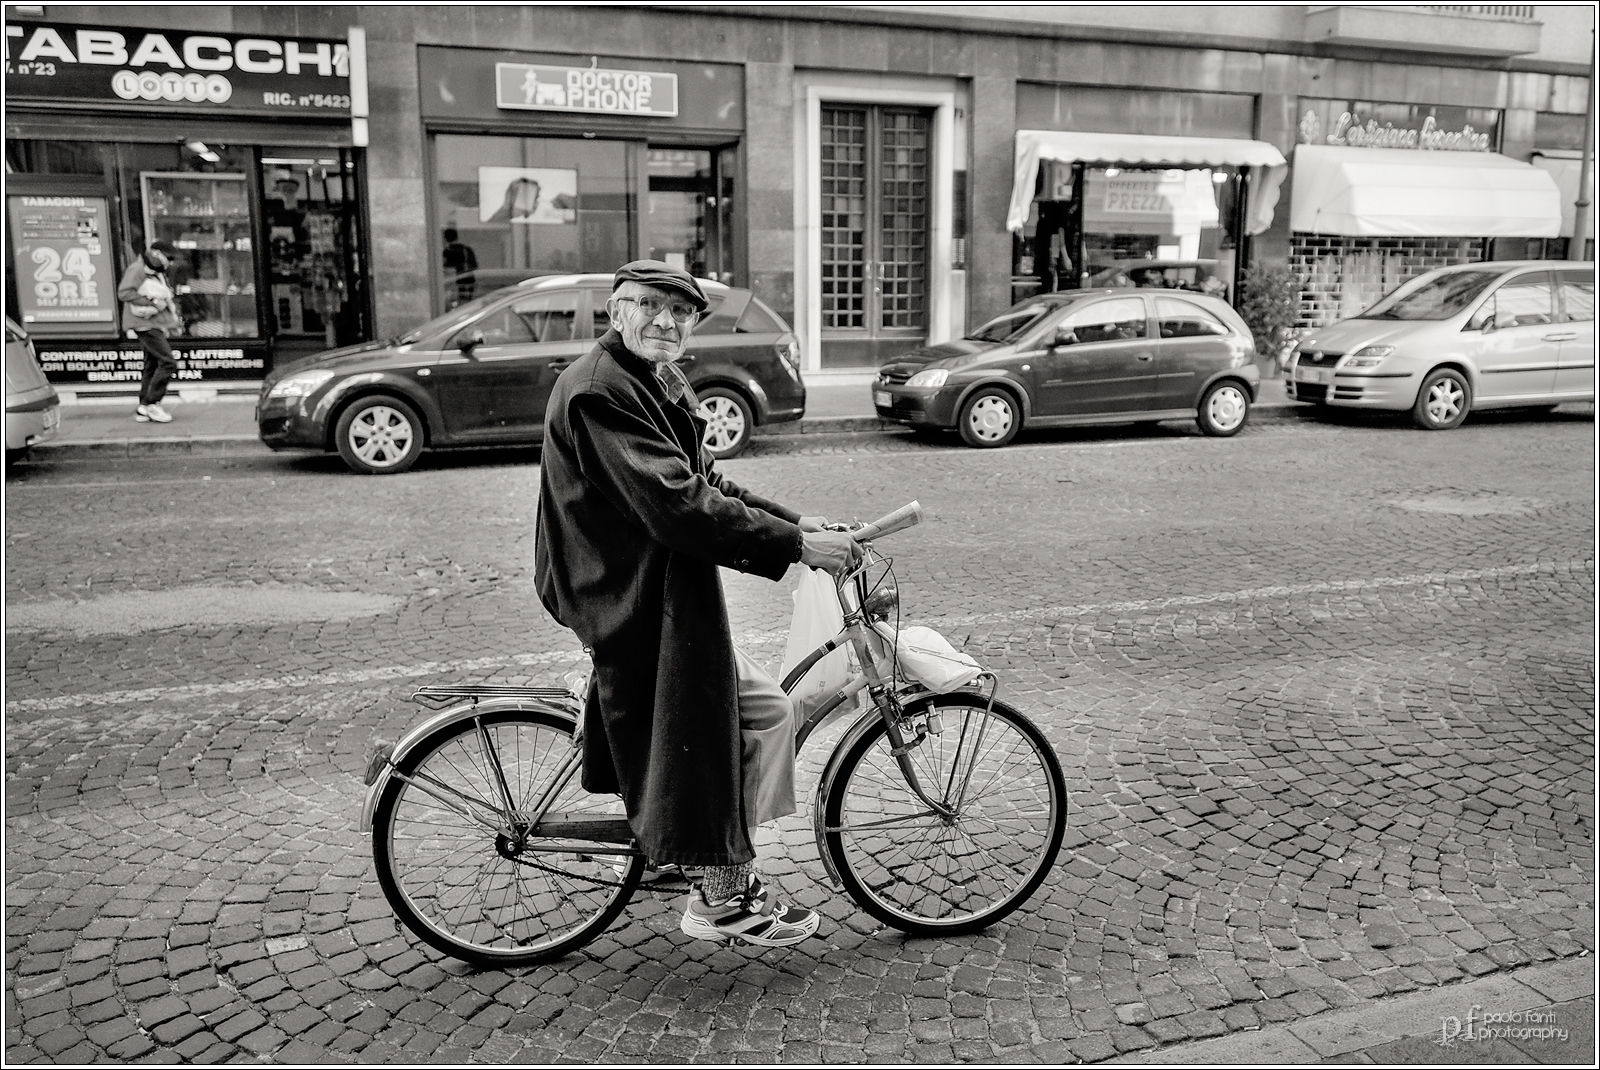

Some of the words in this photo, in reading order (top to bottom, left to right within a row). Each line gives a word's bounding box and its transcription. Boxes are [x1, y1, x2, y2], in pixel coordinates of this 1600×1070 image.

[567, 70, 652, 92] DOCTOR
[263, 91, 296, 106] RIC.
[567, 87, 652, 111] PHONE
[21, 196, 85, 207] TABACCHI
[1107, 193, 1166, 211] PREZZI
[31, 246, 97, 282] 24
[34, 280, 98, 300] ORE
[37, 298, 58, 307] SELF
[60, 298, 99, 307] SERVICE
[40, 350, 118, 361] CONTRIBUTO
[189, 349, 244, 360] LOTTERIE
[40, 361, 63, 372] ORI
[66, 361, 115, 371] BOLLATI
[188, 359, 264, 369] TELEFONICHE
[87, 371, 142, 381] BIGLIETTI
[178, 370, 202, 380] FAX
